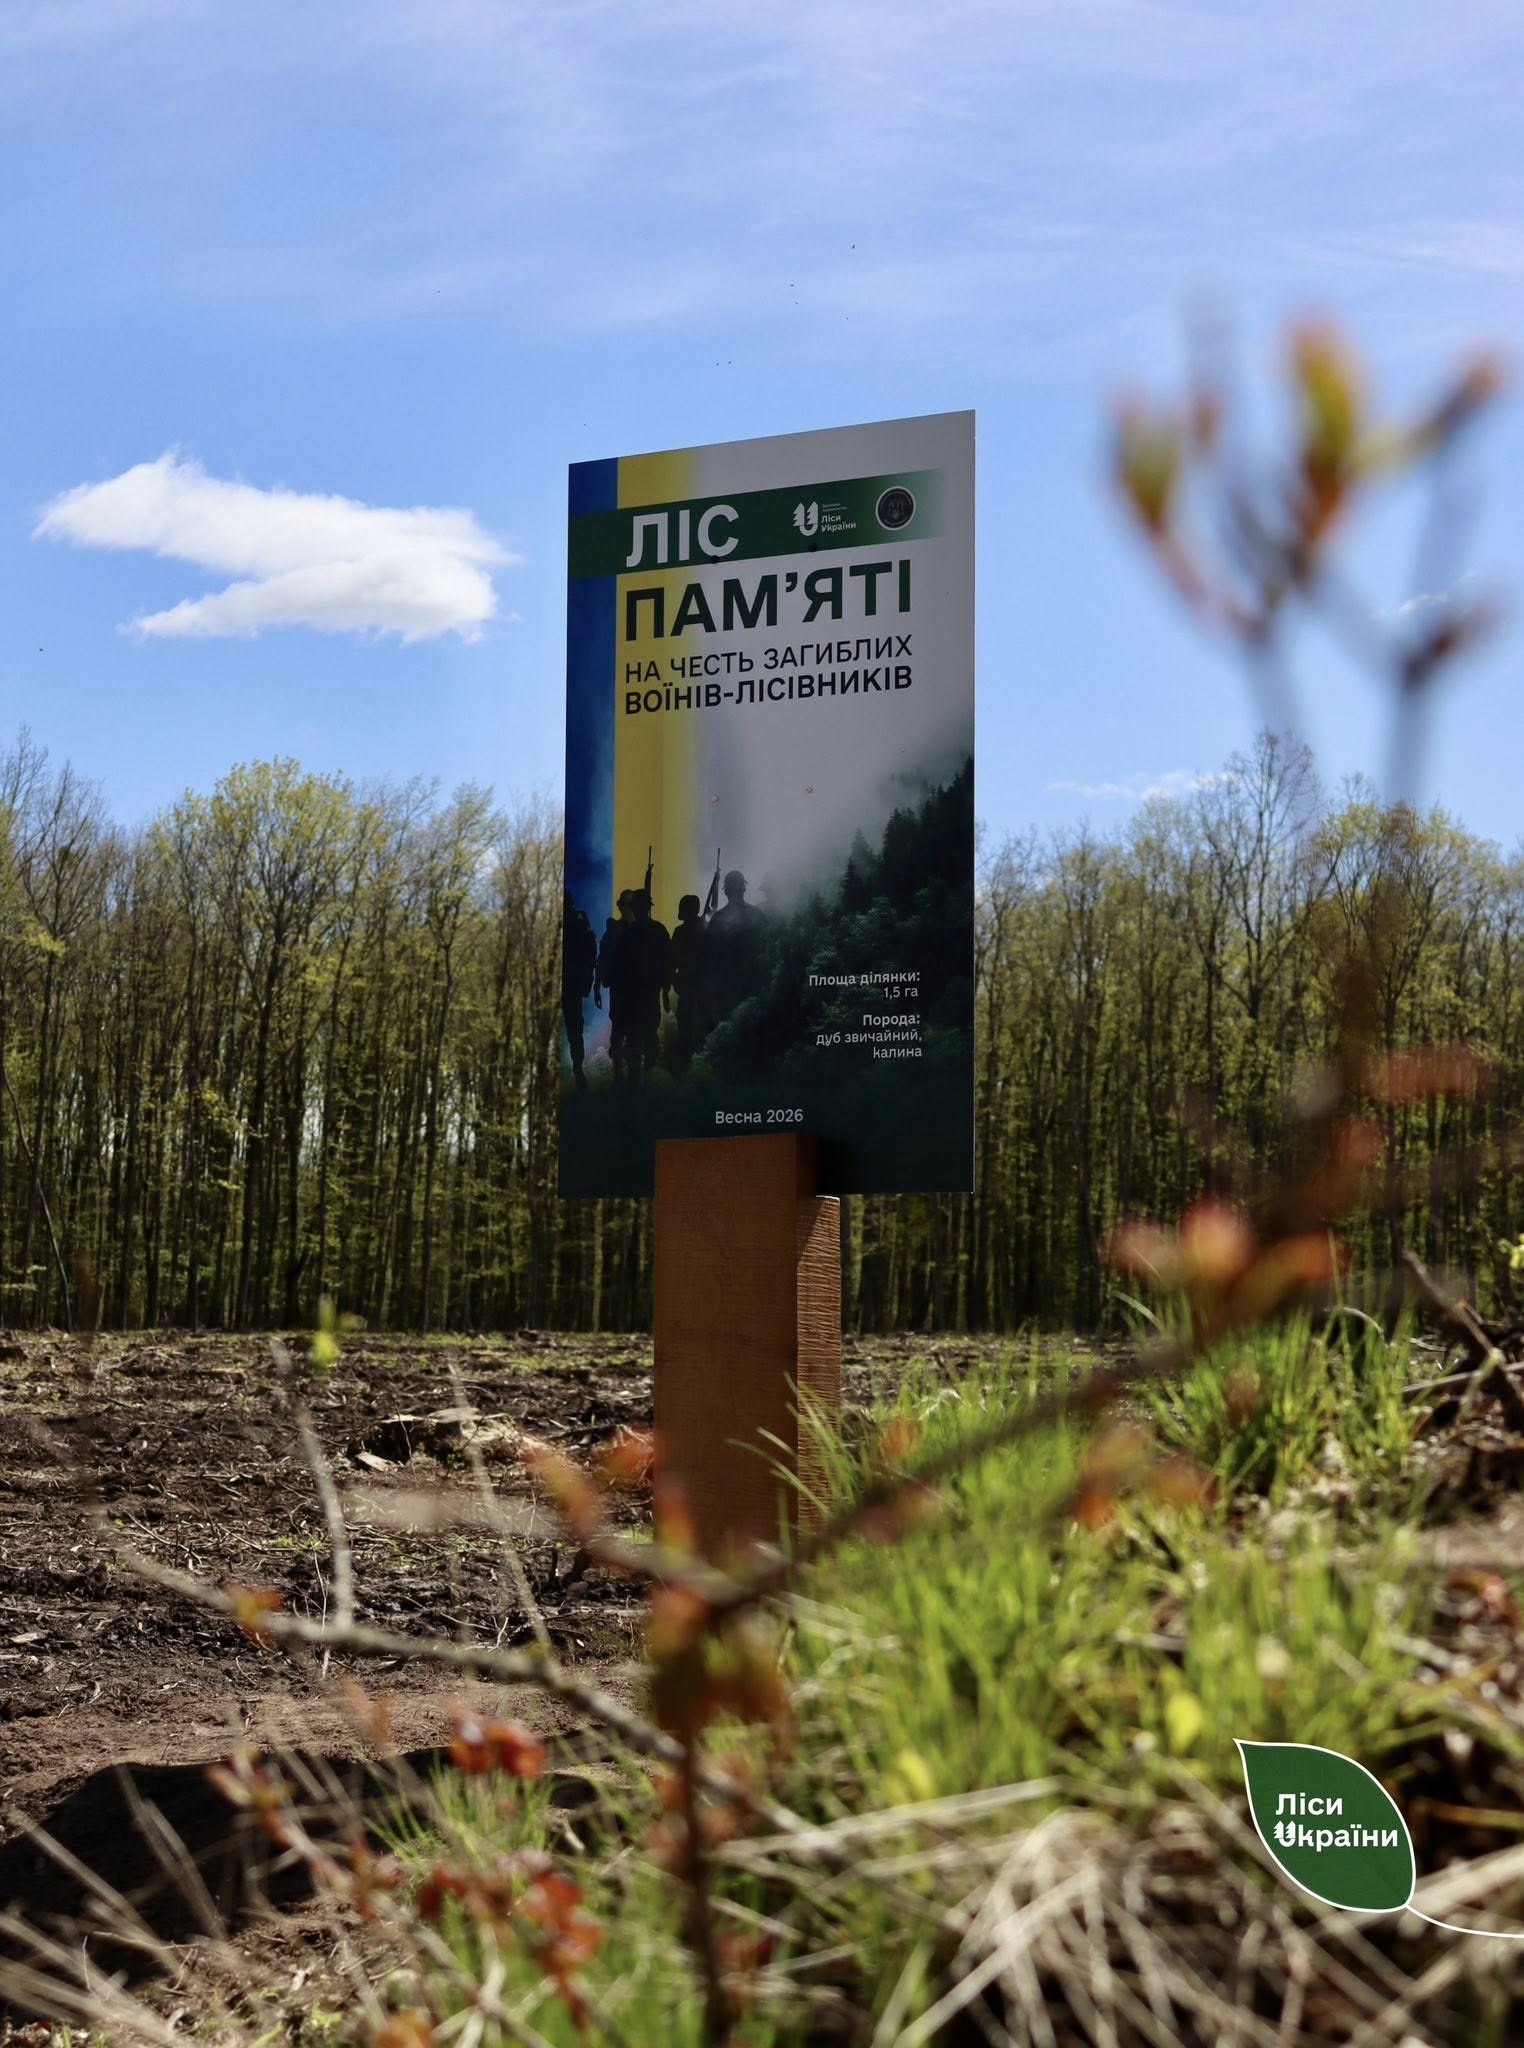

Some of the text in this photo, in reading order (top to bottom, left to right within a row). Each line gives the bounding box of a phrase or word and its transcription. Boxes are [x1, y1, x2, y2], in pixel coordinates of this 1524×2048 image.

[626, 504, 740, 568] ЛІС
[625, 634, 913, 683] НА ЧЕСТЬ ЗАГИБЛИХ
[625, 665, 913, 715] ВОЇНІВ-ЛІСІВНИКІВ
[809, 971, 921, 987] Площа ділянки:
[884, 986, 919, 999] 1,5 га
[863, 1014, 921, 1028] Порода:
[816, 1029, 922, 1046] дуб звичайний,
[873, 1046, 922, 1058] калина
[715, 1108, 804, 1124] Весна 2026
